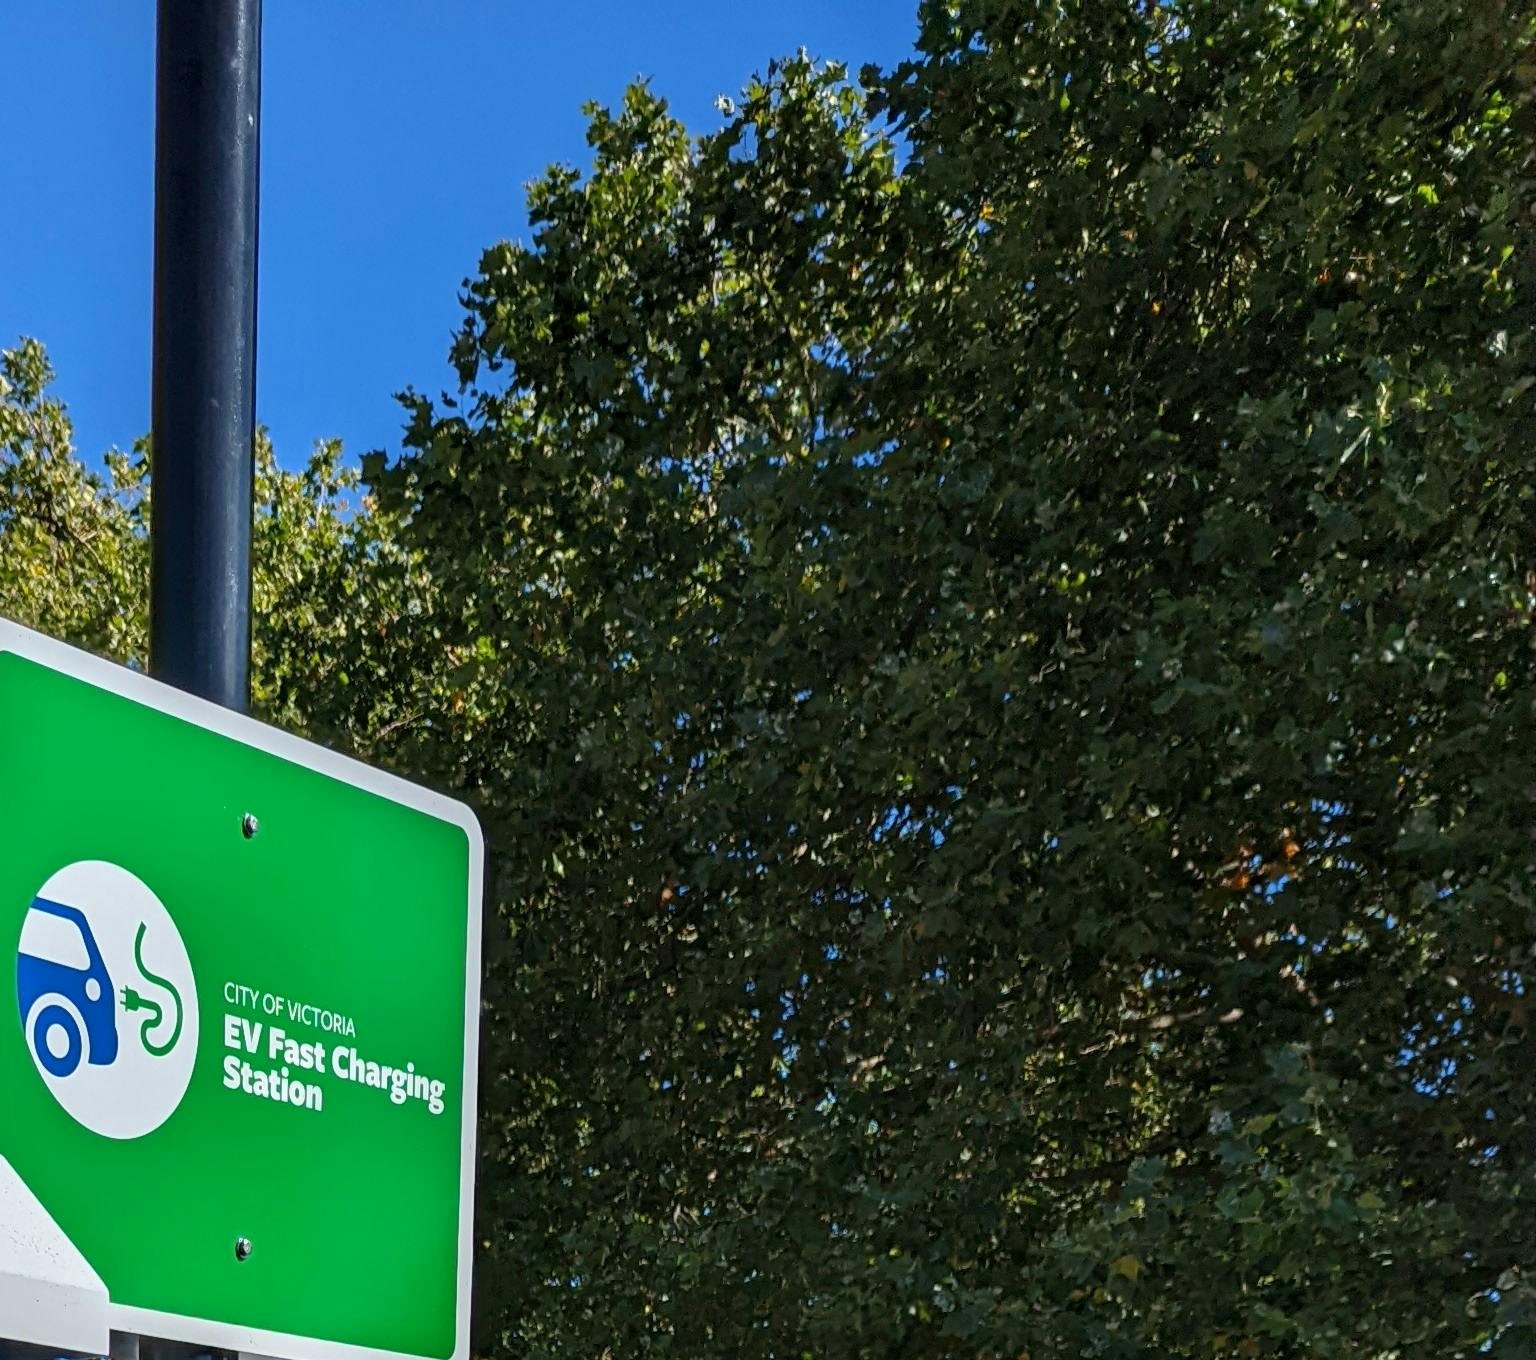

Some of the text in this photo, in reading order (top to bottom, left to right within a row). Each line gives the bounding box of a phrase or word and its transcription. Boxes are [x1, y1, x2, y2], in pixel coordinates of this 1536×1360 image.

[224, 982, 356, 1038] CITY OF VICTORIA
[223, 1055, 322, 1111] Station
[224, 1014, 445, 1115] EV Fast Charging
